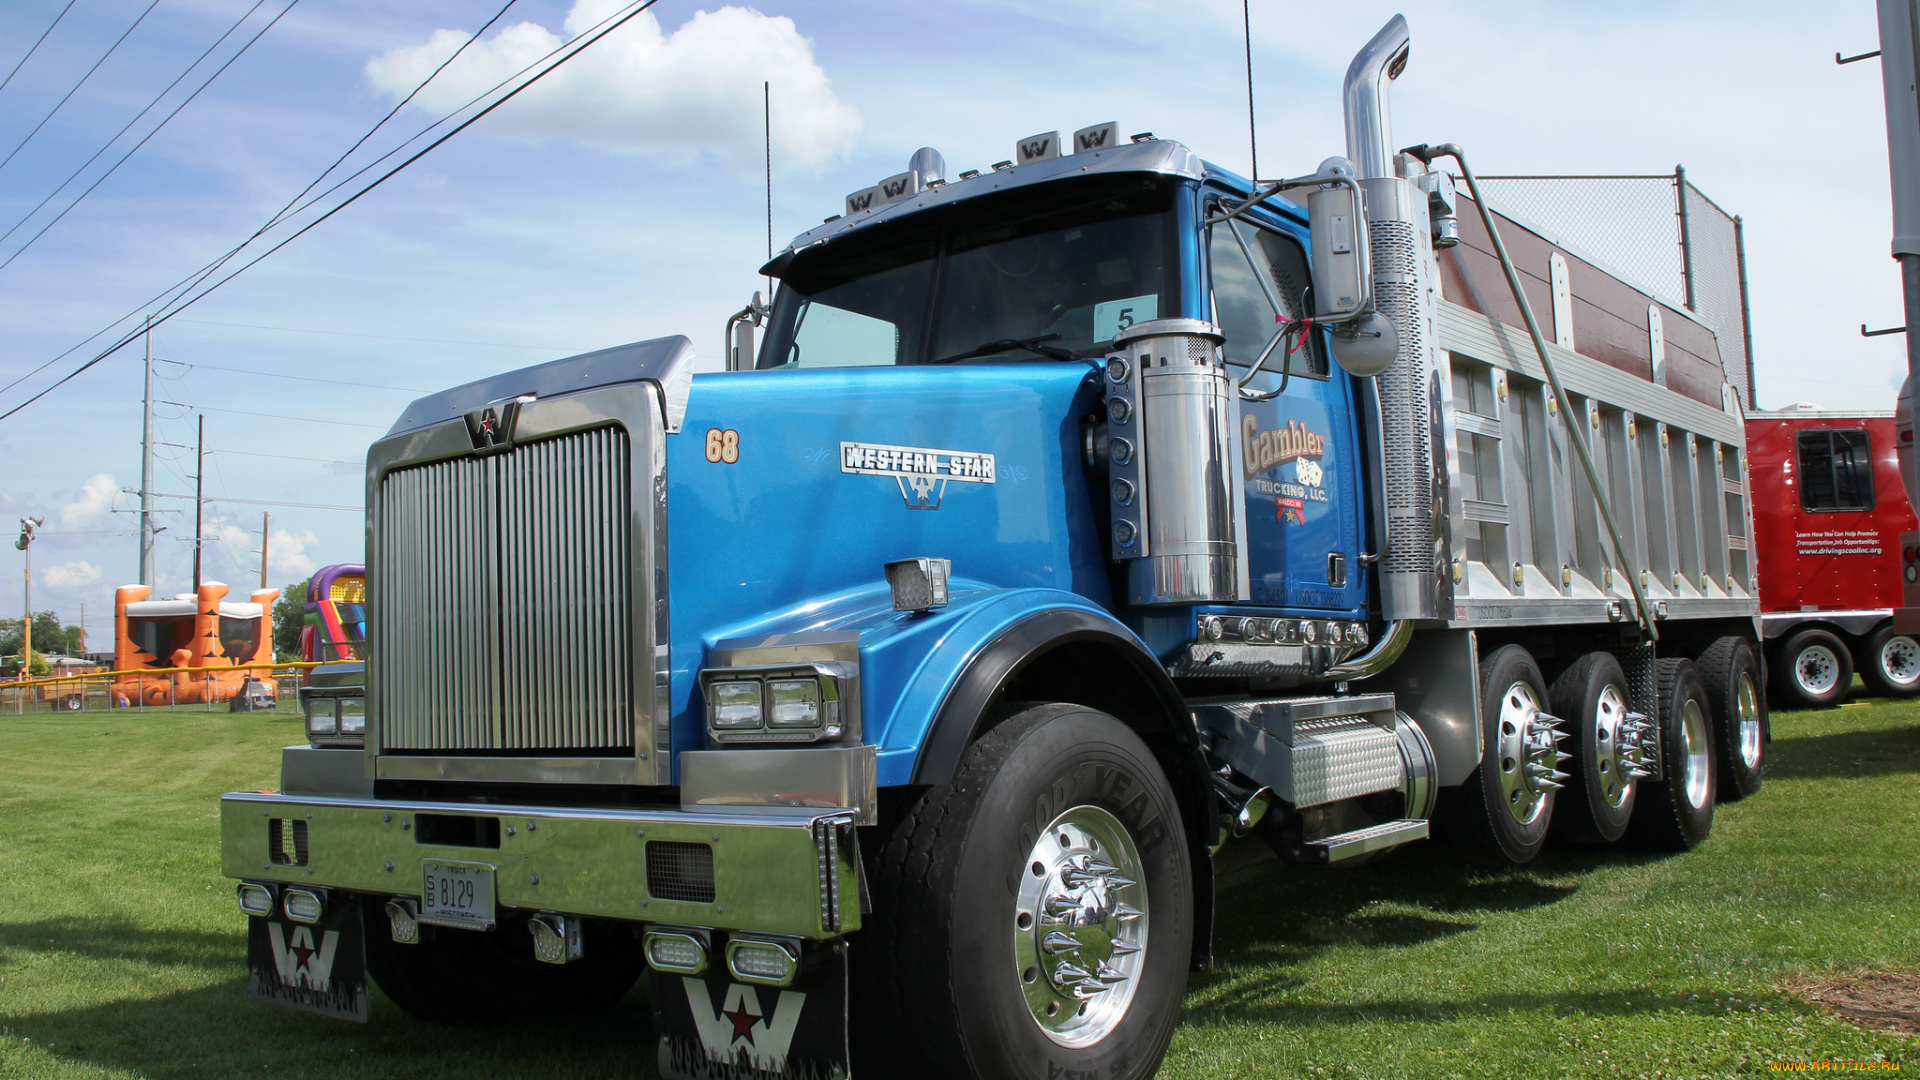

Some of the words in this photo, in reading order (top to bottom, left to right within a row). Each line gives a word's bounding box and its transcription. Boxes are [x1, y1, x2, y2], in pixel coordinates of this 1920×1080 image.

[1117, 307, 1135, 331] 5
[705, 428, 740, 464] 68
[1242, 413, 1325, 475] Gambler
[846, 446, 939, 474] WESTERN
[949, 454, 993, 478] STAR
[1256, 479, 1308, 500] TRUCKING,
[1295, 589, 1318, 606] USDOT
[441, 877, 474, 909] 8129
